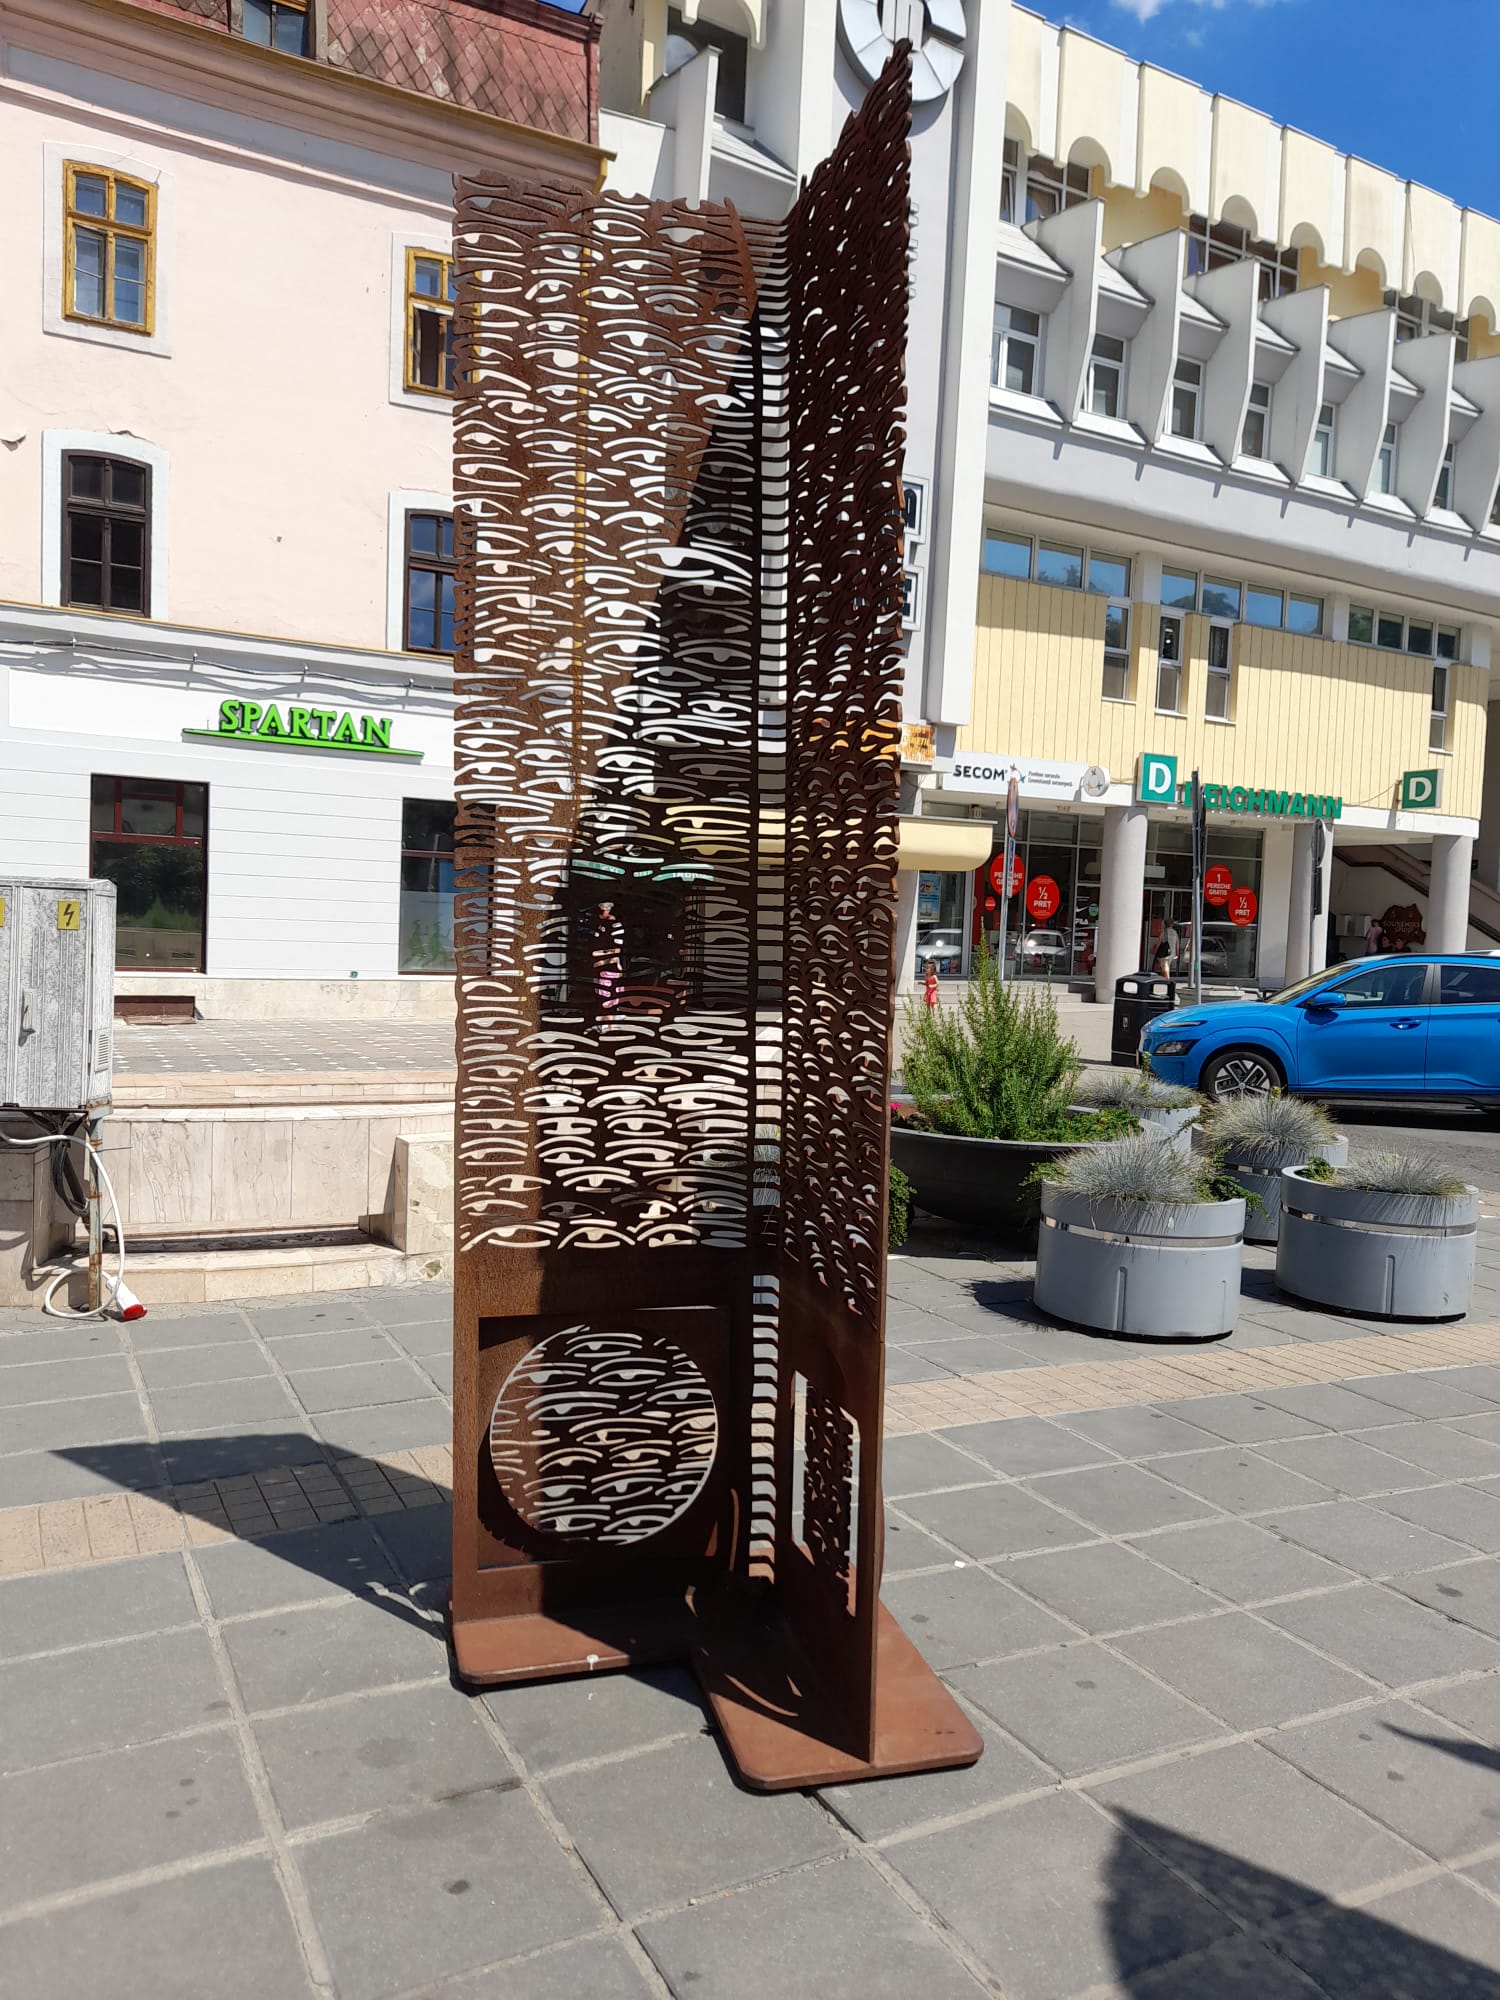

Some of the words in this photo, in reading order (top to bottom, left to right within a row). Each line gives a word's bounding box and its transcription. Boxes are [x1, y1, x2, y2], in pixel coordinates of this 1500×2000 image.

[219, 699, 393, 748] SPARTAN
[953, 764, 1005, 782] SECOM
[1149, 761, 1172, 794] D
[1408, 777, 1432, 802] D
